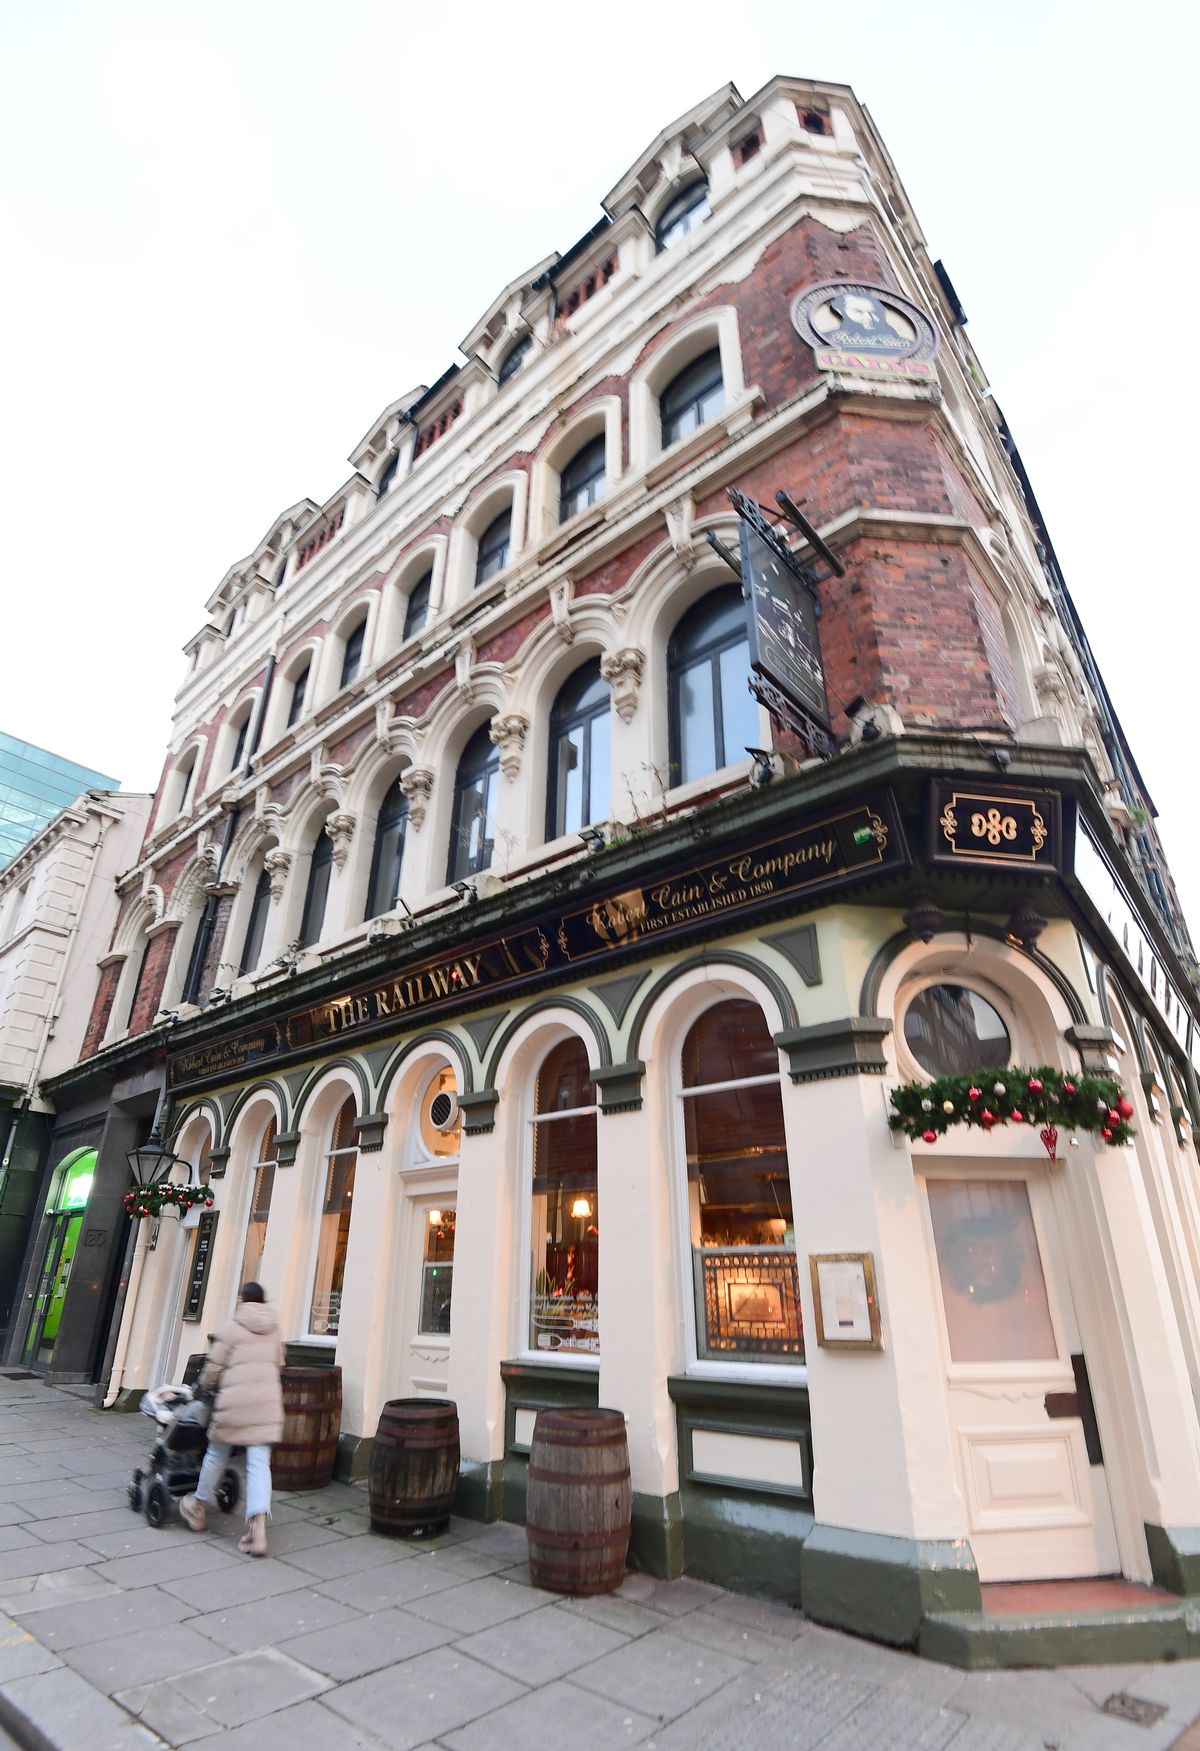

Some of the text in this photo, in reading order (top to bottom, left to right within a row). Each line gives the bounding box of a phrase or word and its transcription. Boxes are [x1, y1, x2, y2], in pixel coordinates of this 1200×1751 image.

[640, 879, 774, 933] FIRST ESTABLISHED 1850
[651, 885, 703, 910] Cain
[709, 871, 728, 893] &
[729, 838, 836, 883] Company
[324, 953, 482, 1033] THE RAILWAY
